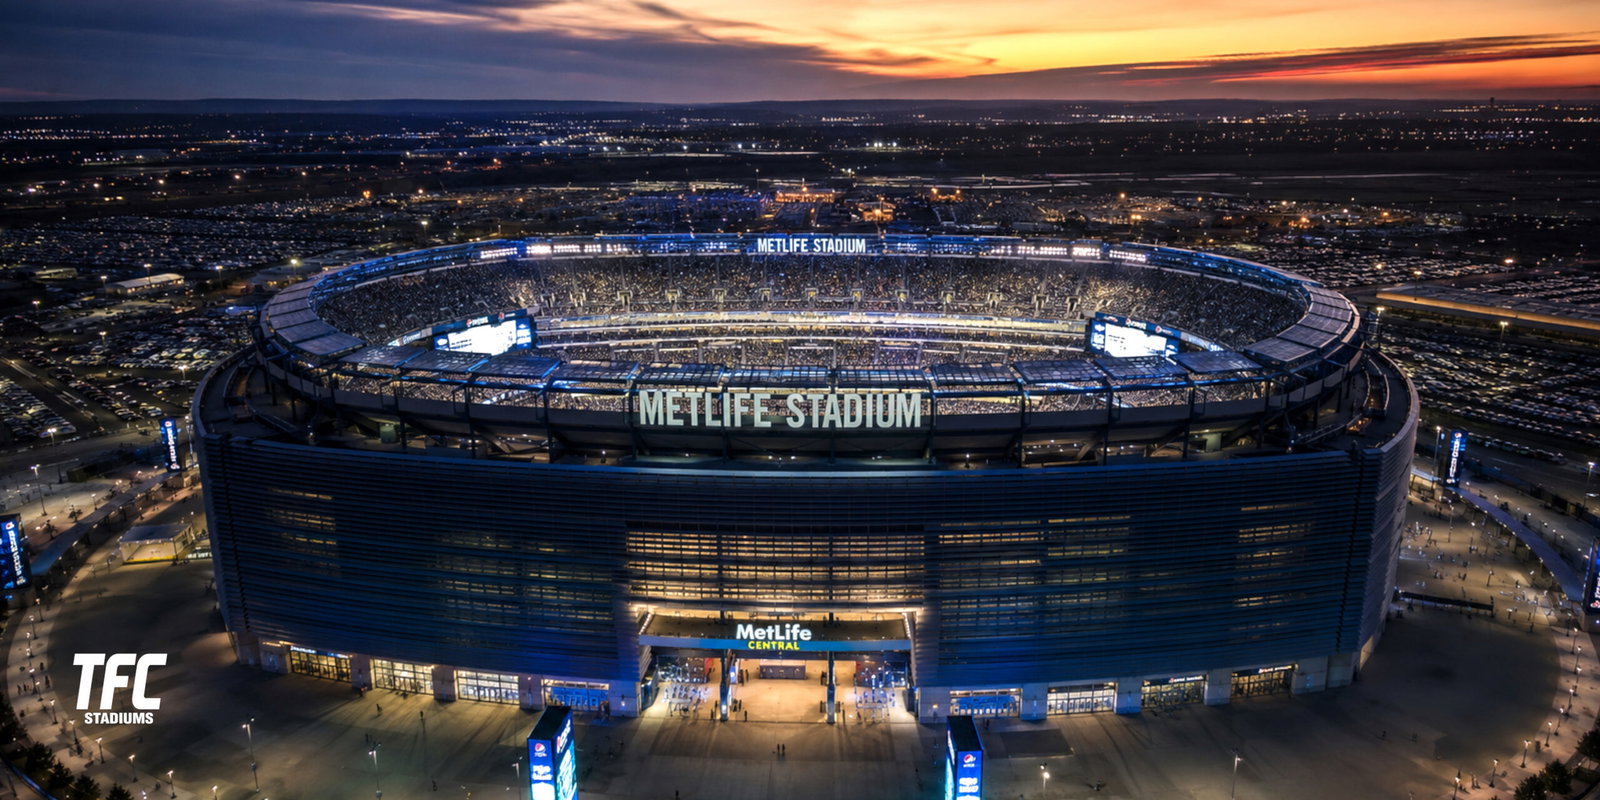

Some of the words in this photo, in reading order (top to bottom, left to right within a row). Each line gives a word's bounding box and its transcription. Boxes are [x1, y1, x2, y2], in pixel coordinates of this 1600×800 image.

[757, 237, 808, 253] METLIFE
[813, 238, 866, 253] STADIUM
[639, 391, 771, 427] METLIFE
[786, 393, 921, 428] STADIUM
[736, 623, 812, 641] MetLife
[748, 641, 800, 651] CENTRAL
